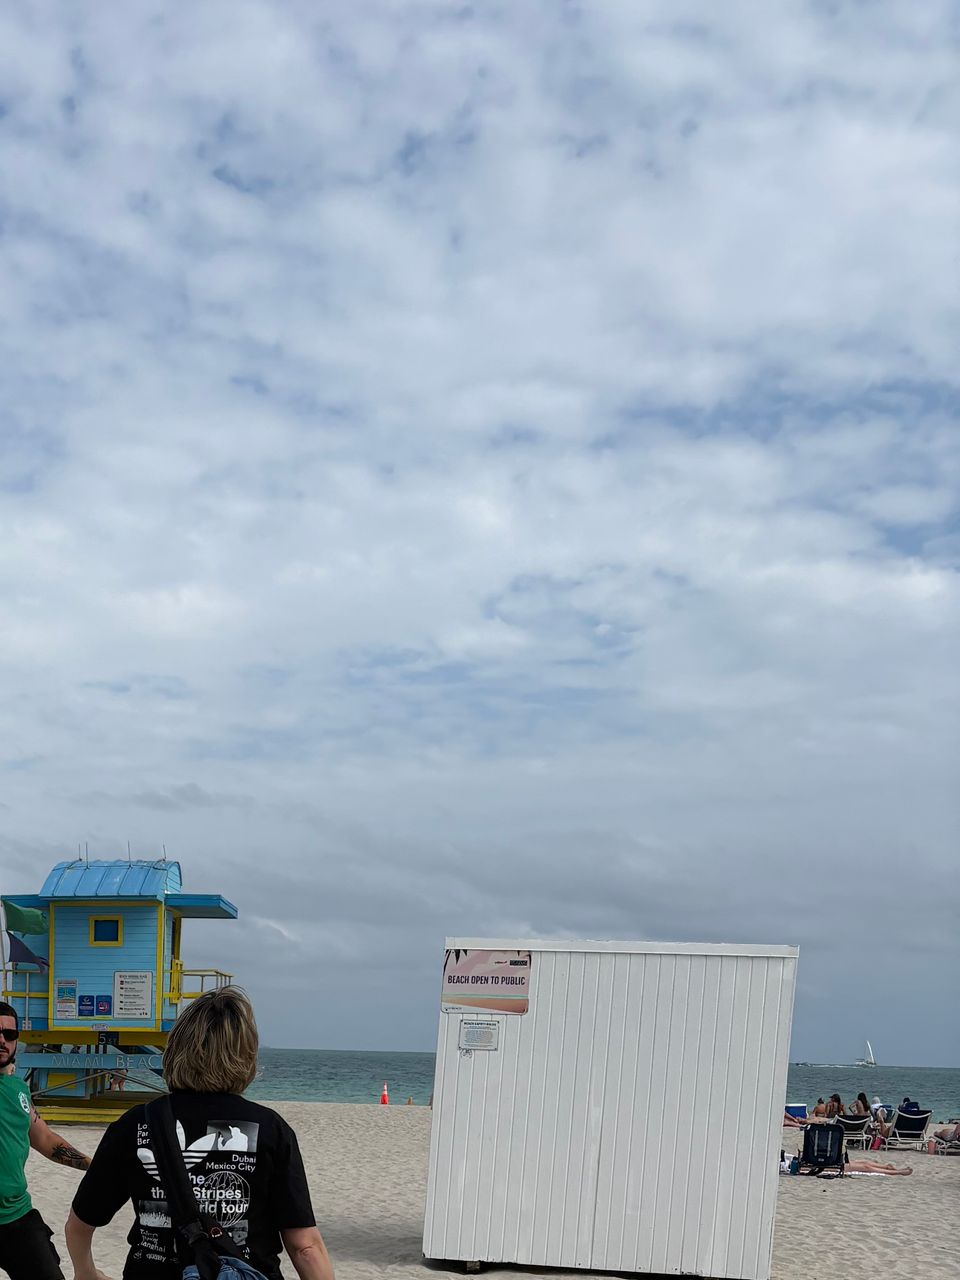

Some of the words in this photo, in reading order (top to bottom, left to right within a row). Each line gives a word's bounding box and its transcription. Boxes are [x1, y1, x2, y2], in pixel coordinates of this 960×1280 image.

[447, 975, 469, 984] BEACH
[471, 975, 489, 985] OPEN
[491, 976, 500, 985] TO
[501, 976, 526, 986] PUBLIC
[52, 1055, 104, 1067] MIAMI
[116, 1055, 161, 1069] BEAC
[137, 1130, 149, 1138] Par
[137, 1138, 150, 1146] Ber
[232, 1154, 257, 1163] Dubai
[206, 1161, 236, 1170] Mexico
[238, 1162, 256, 1173] City
[188, 1172, 205, 1184] he
[192, 1187, 242, 1201] Stripes
[199, 1201, 218, 1213] rld
[221, 1201, 249, 1213] tour
